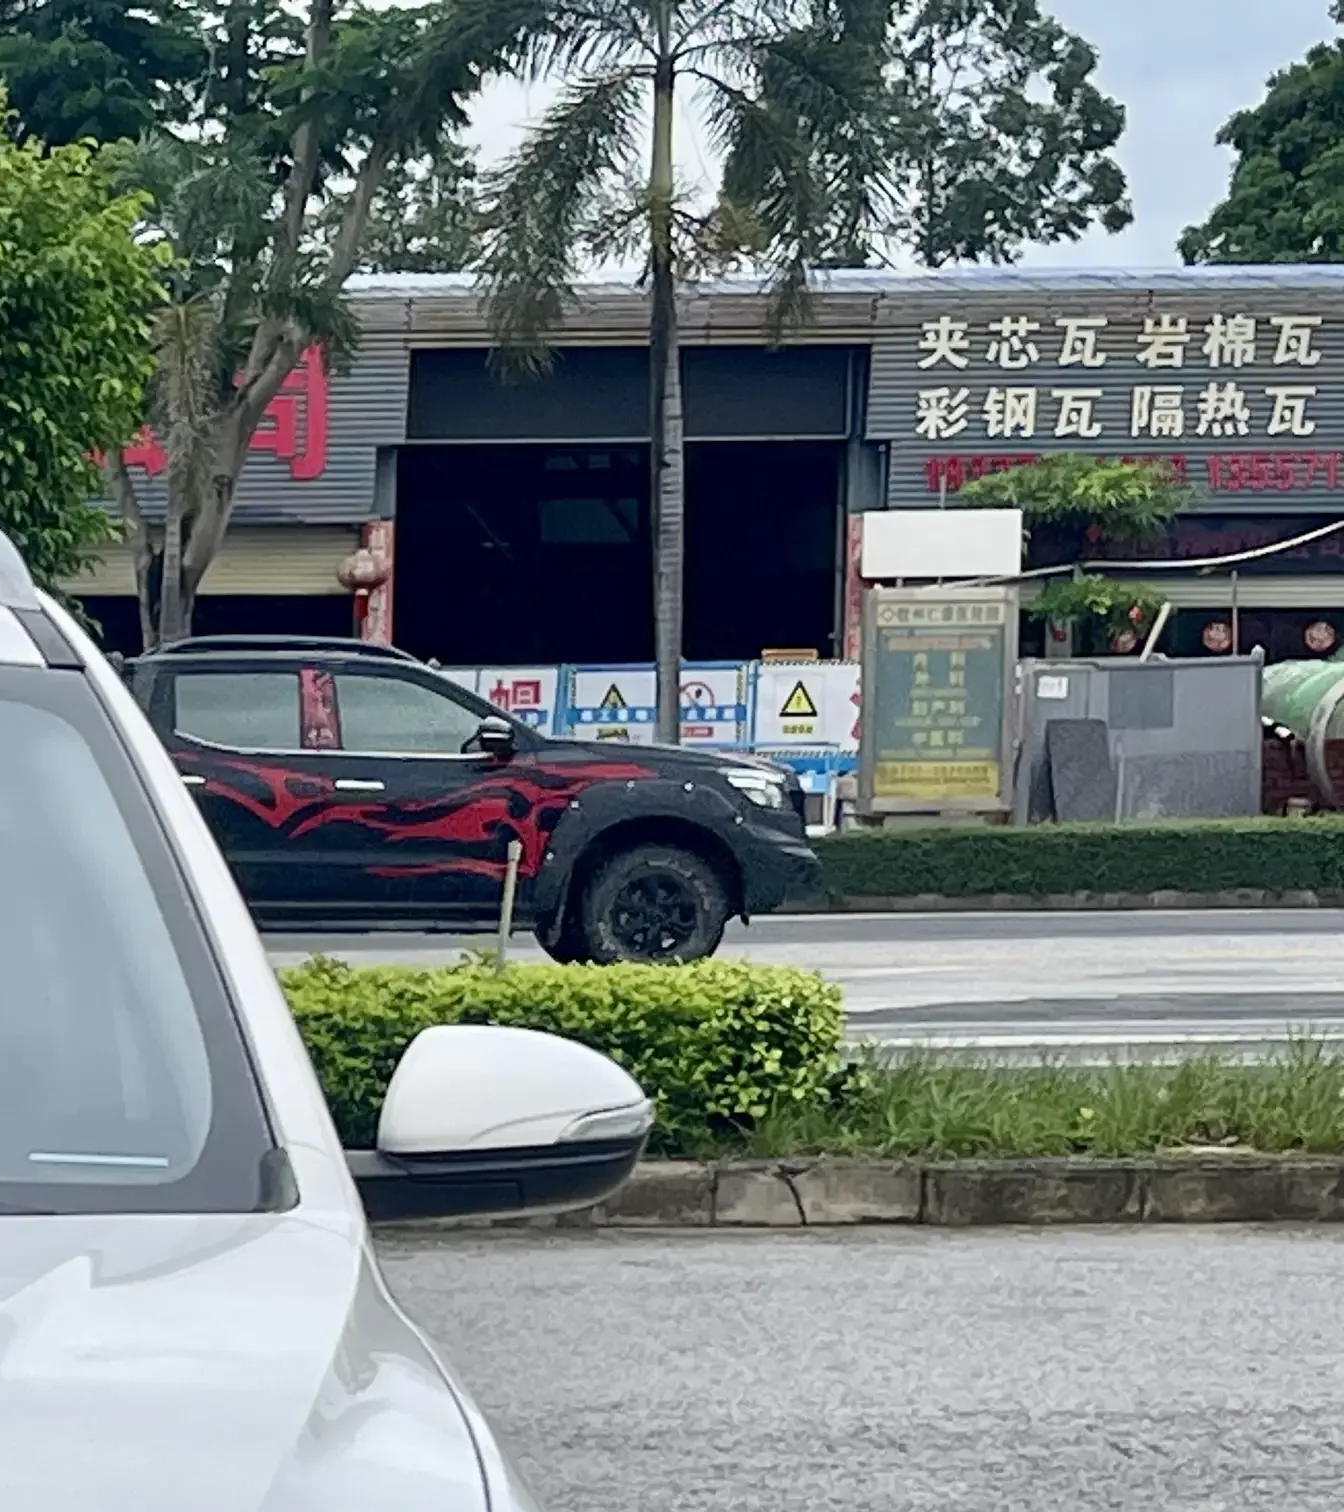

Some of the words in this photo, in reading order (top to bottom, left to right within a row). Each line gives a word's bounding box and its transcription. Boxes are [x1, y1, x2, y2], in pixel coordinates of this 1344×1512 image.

[917, 315, 1109, 371] 夹芯瓦
[1136, 312, 1324, 369] 岩棉瓦
[915, 384, 1104, 441] 彩钢瓦
[1130, 381, 1318, 439] 隔热瓦
